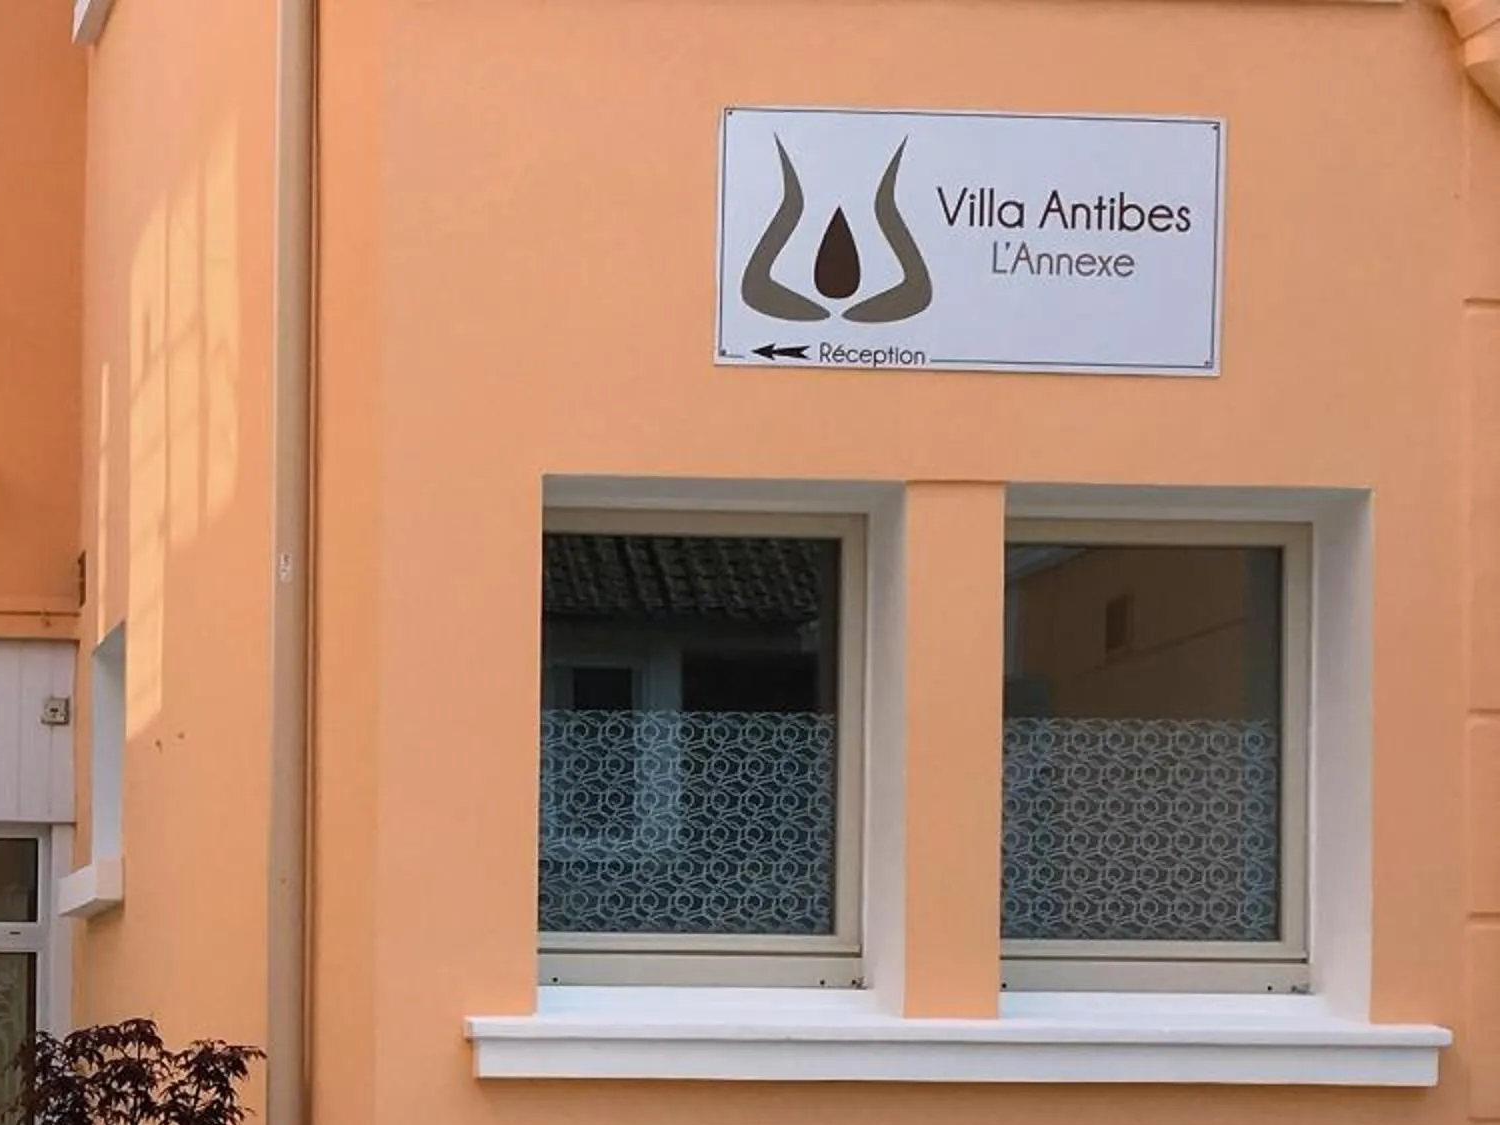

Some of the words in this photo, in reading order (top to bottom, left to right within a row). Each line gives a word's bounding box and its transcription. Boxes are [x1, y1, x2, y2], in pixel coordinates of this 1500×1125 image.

[937, 187, 1025, 229] Villa
[1038, 190, 1192, 233] Antibes
[992, 240, 1136, 277] L'Annexe
[819, 342, 926, 367] Réception
